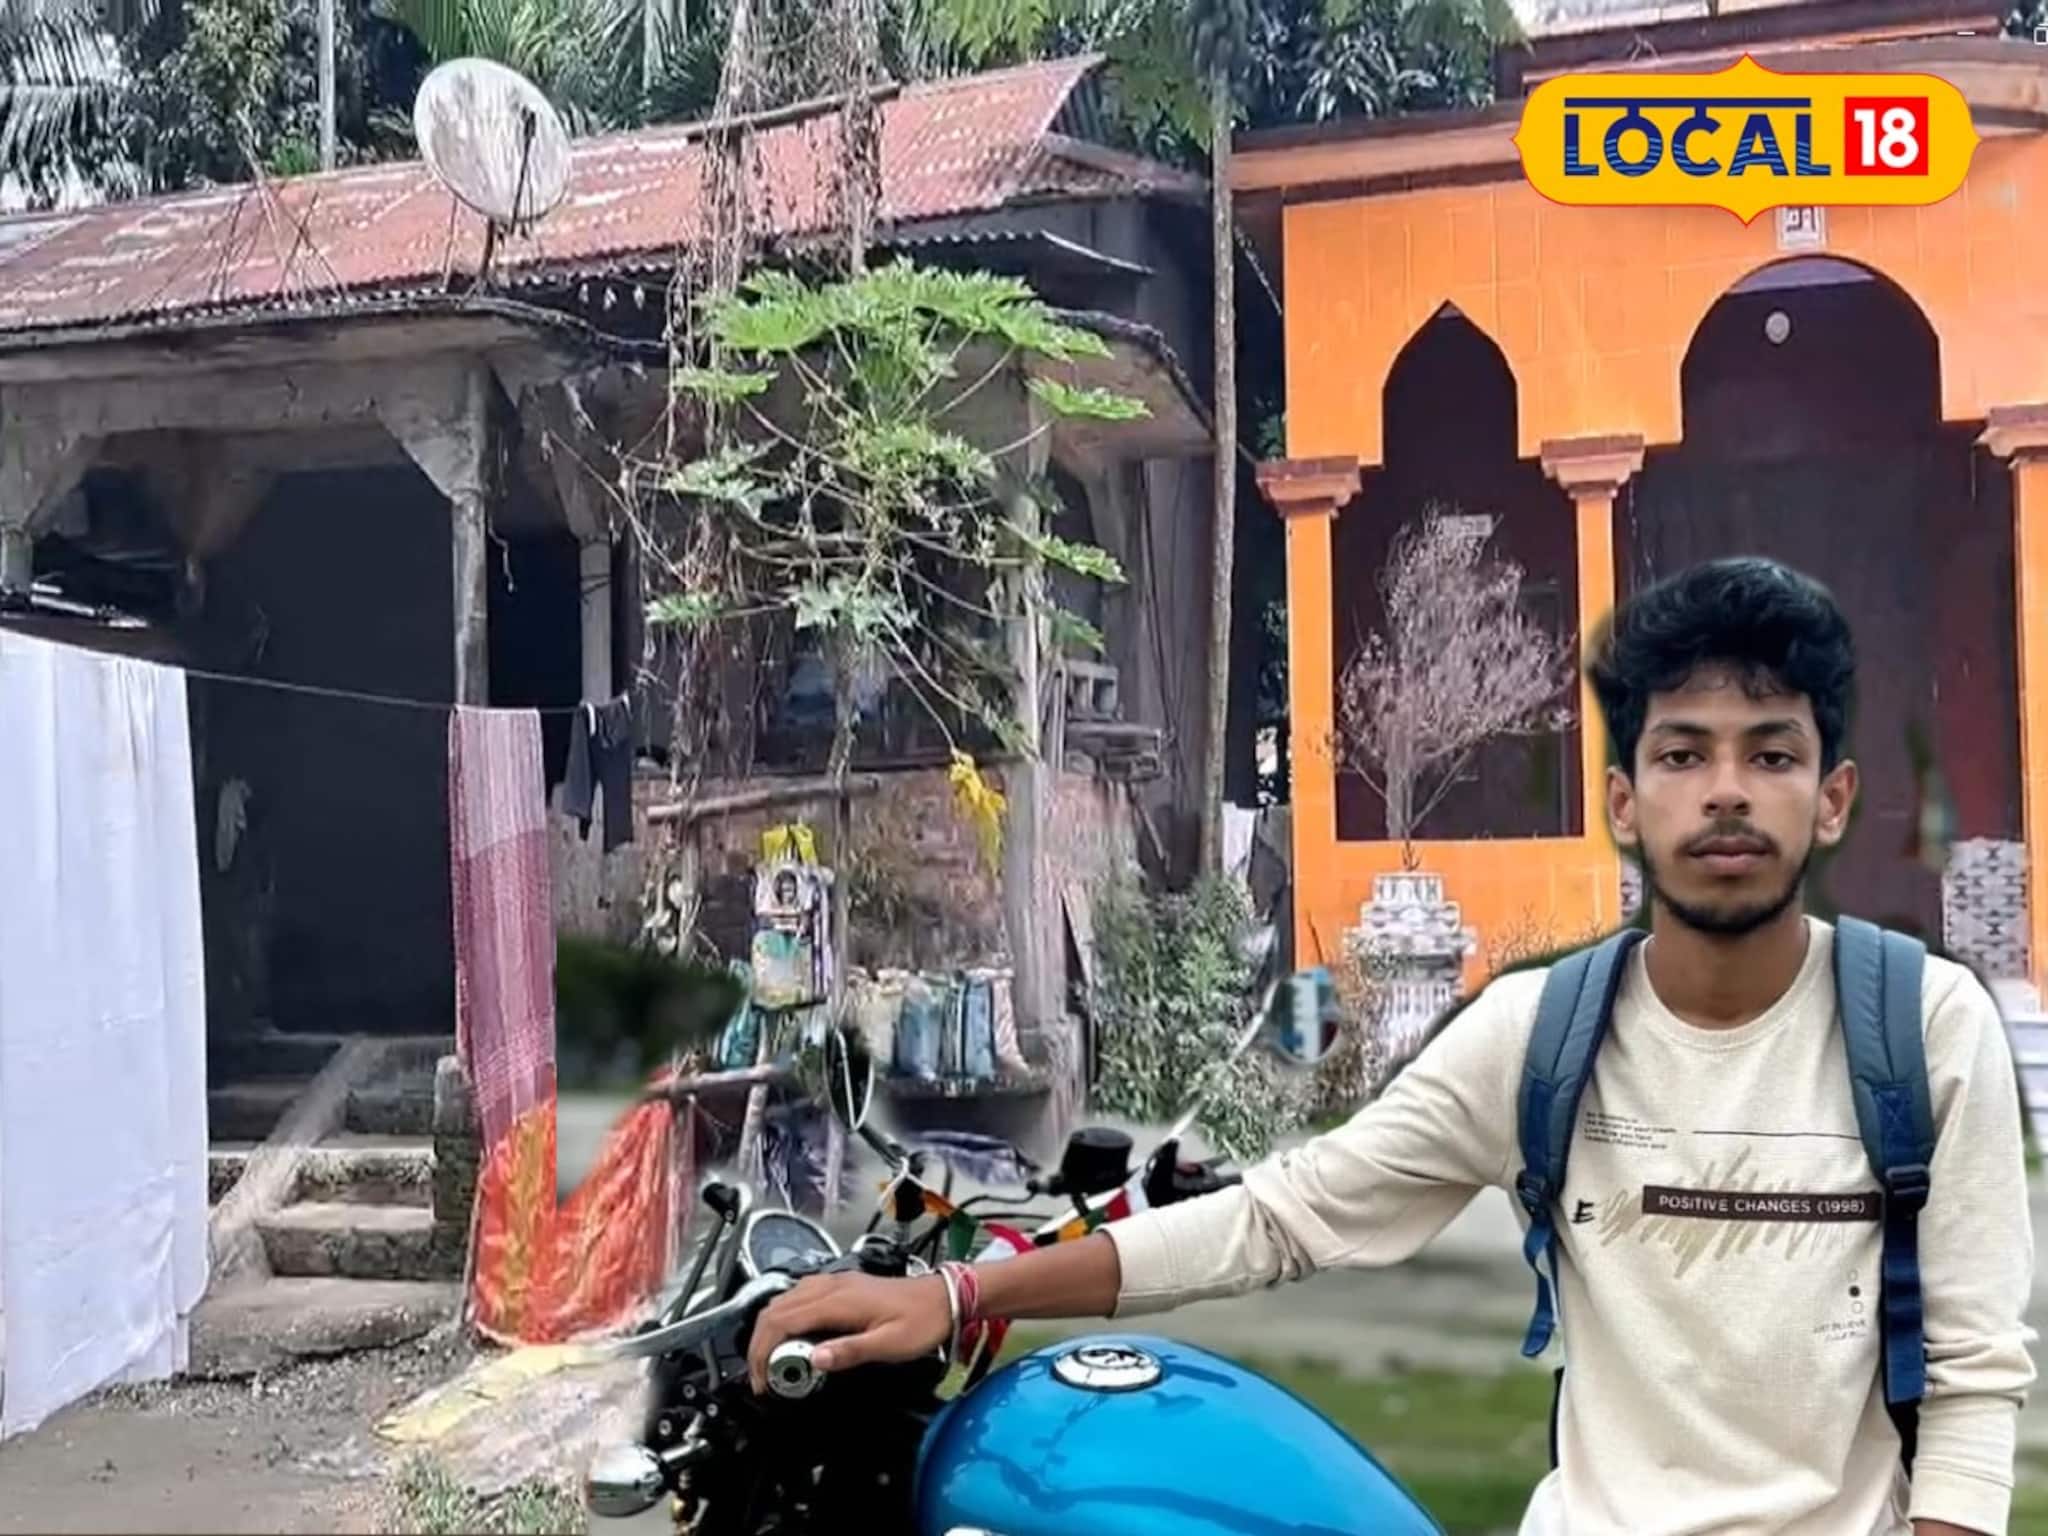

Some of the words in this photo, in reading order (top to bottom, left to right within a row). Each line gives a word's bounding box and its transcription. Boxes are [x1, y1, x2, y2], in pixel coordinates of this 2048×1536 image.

[1658, 1194, 1728, 1212] POSITIVE
[1734, 1198, 1811, 1214] CHANGES
[1817, 1200, 1865, 1214] (1998)
